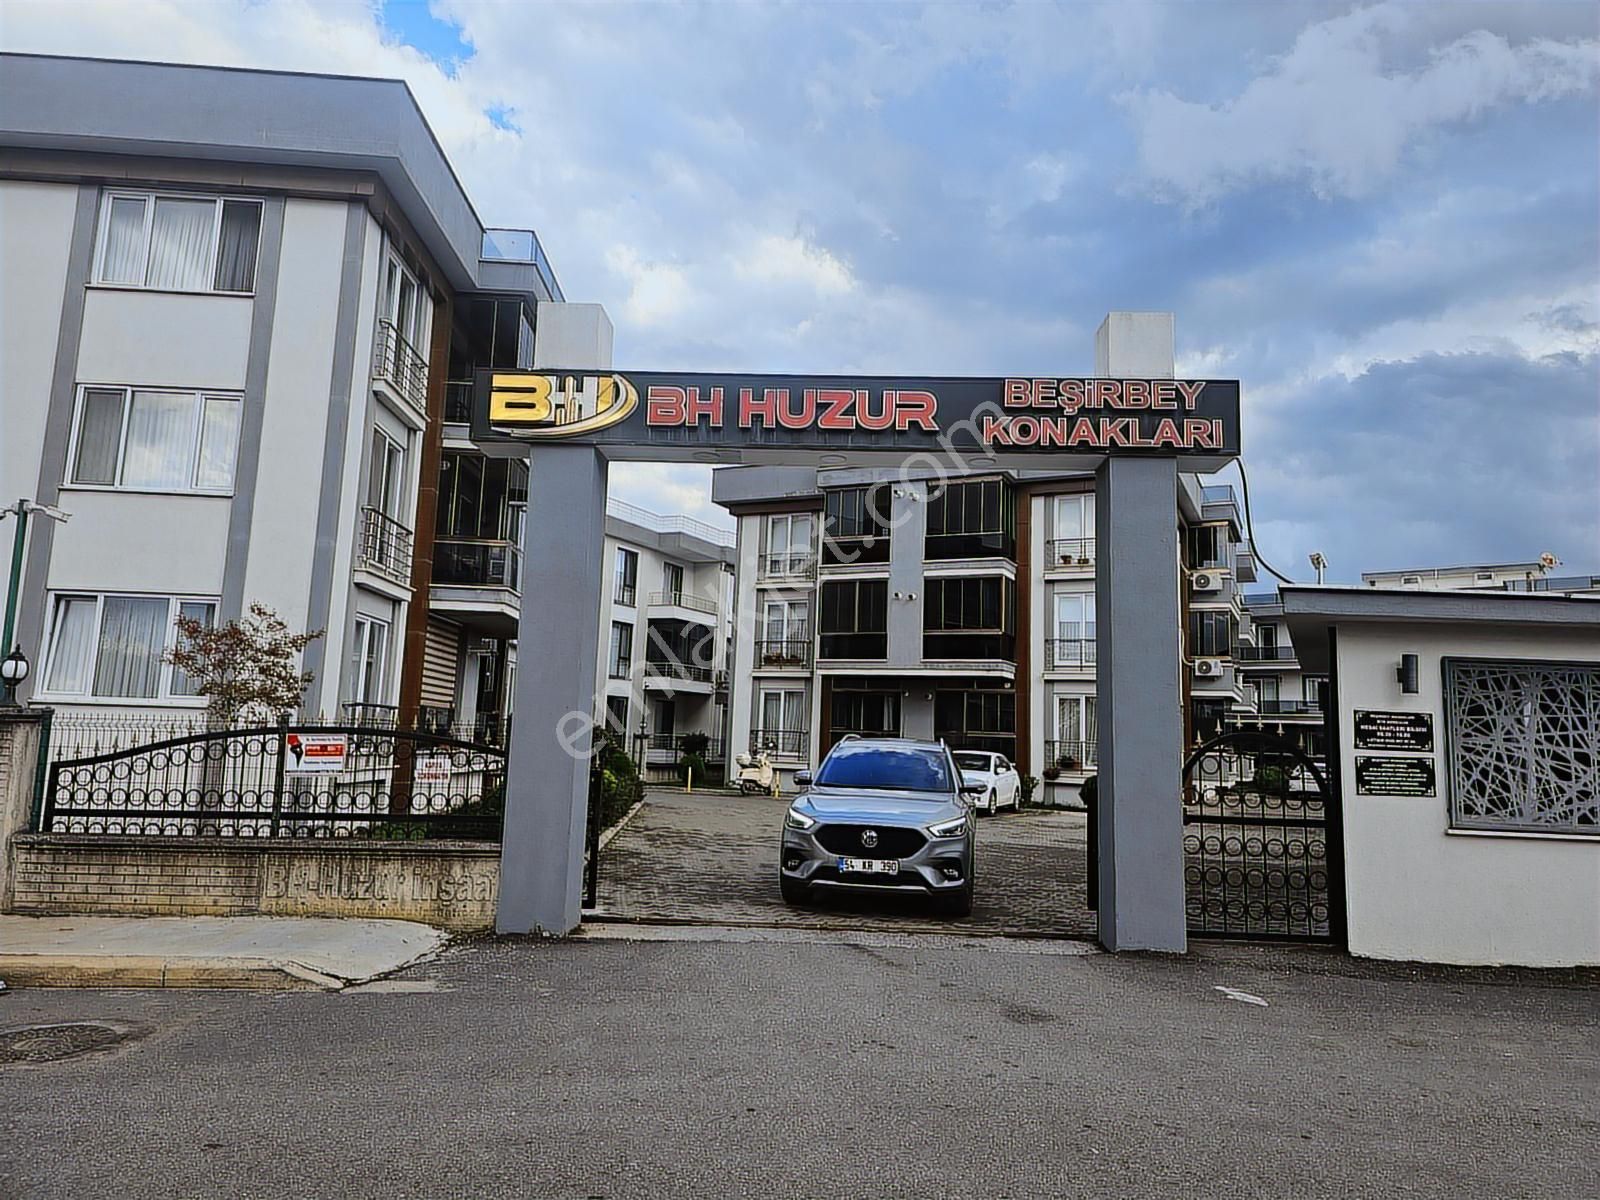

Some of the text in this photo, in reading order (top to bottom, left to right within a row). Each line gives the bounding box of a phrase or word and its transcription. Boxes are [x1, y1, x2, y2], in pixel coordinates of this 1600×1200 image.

[647, 386, 940, 431] BH HUZUR
[983, 415, 1224, 449] KONAKLARI
